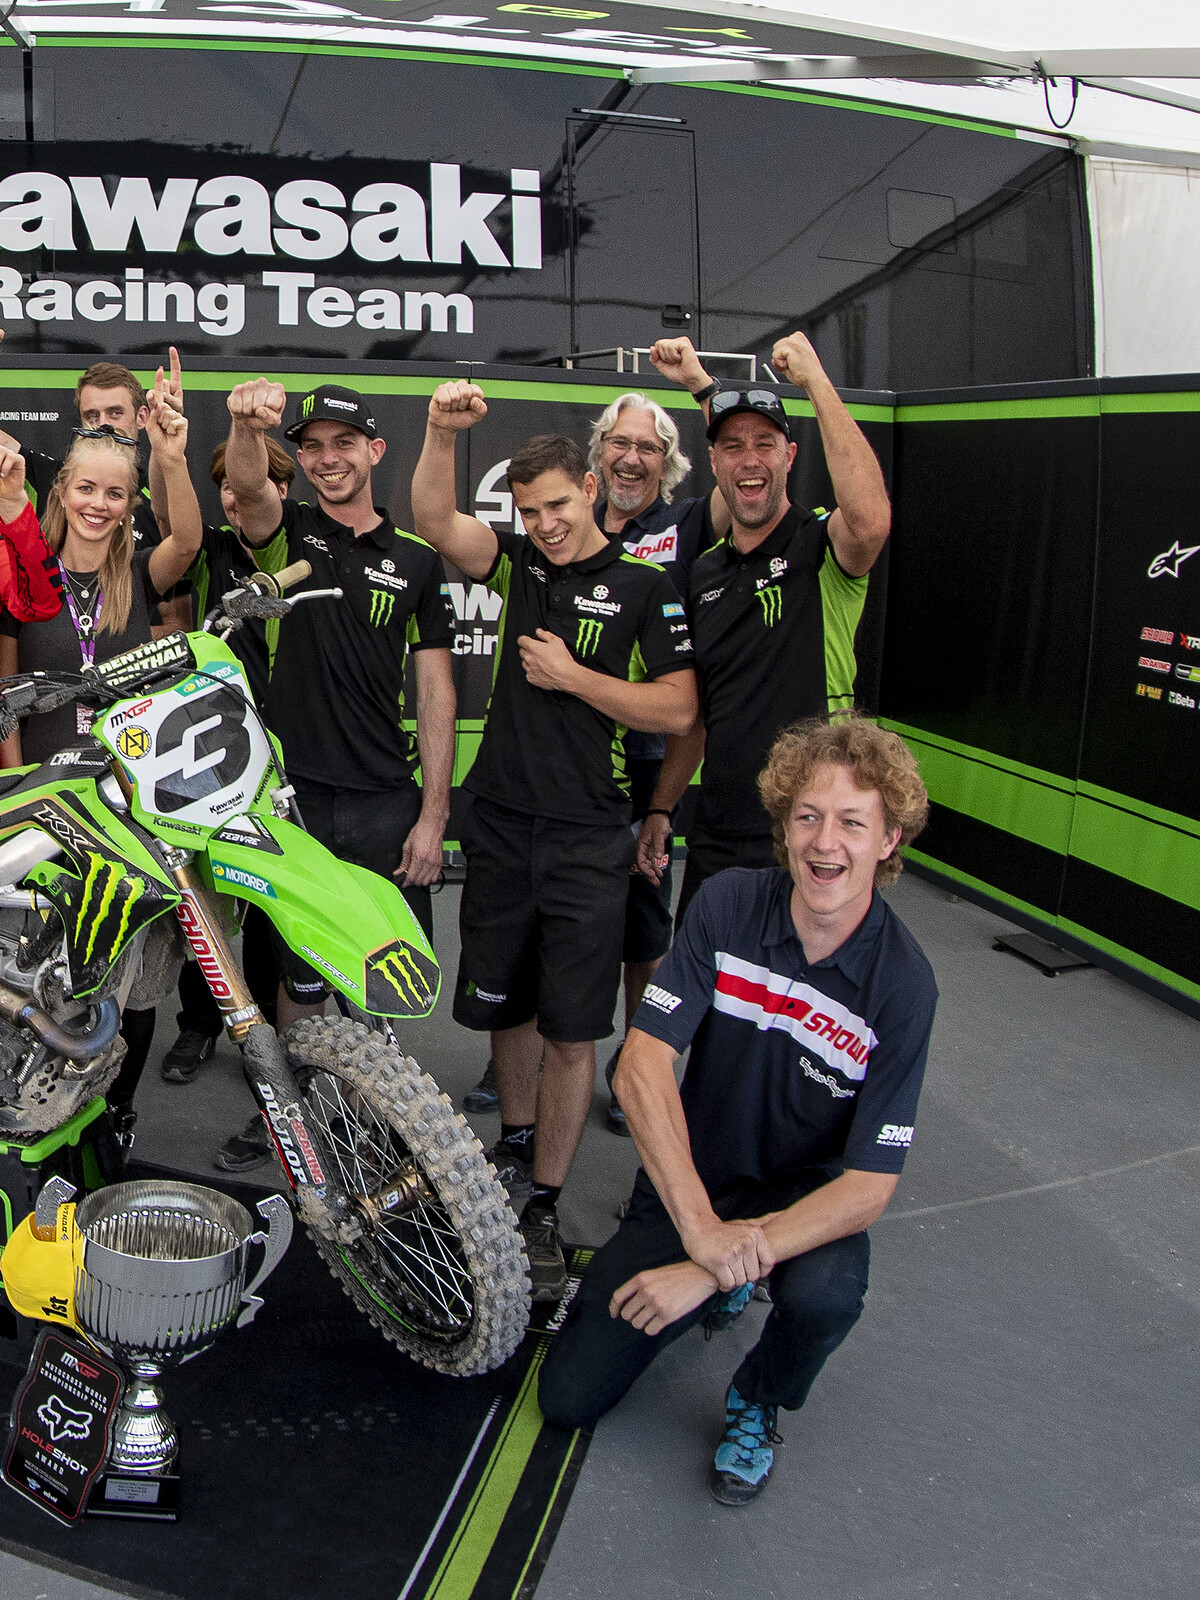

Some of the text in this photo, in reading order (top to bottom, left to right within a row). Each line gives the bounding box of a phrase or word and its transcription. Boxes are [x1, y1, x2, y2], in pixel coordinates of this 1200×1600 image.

[261, 271, 475, 334] Team
[21, 412, 39, 421] TEAM
[364, 566, 408, 588] Kawasaki
[574, 595, 622, 613] Kawasaki
[110, 698, 154, 729] MXGP
[154, 683, 252, 815] 3
[209, 791, 245, 814] Kawasaki
[153, 816, 202, 836] Kawasaki
[220, 831, 262, 846] FEBVRE
[225, 867, 270, 895] MOTOREX
[175, 902, 234, 1000] SHOWA
[300, 945, 360, 990] PRO CIRCUIT
[642, 983, 683, 1012] OWA
[878, 1124, 915, 1143] SHO
[385, 1192, 400, 1210] 3
[41, 1296, 69, 1319] 1st
[546, 1277, 583, 1331] Kawasaki
[60, 1351, 100, 1380] MXGP
[40, 1367, 108, 1415] CHAMPIONSHIP 2020
[44, 1360, 108, 1405] MOTOCROSS WORLD
[20, 1427, 89, 1476] HOLESHOT
[34, 1451, 65, 1476] AWARD
